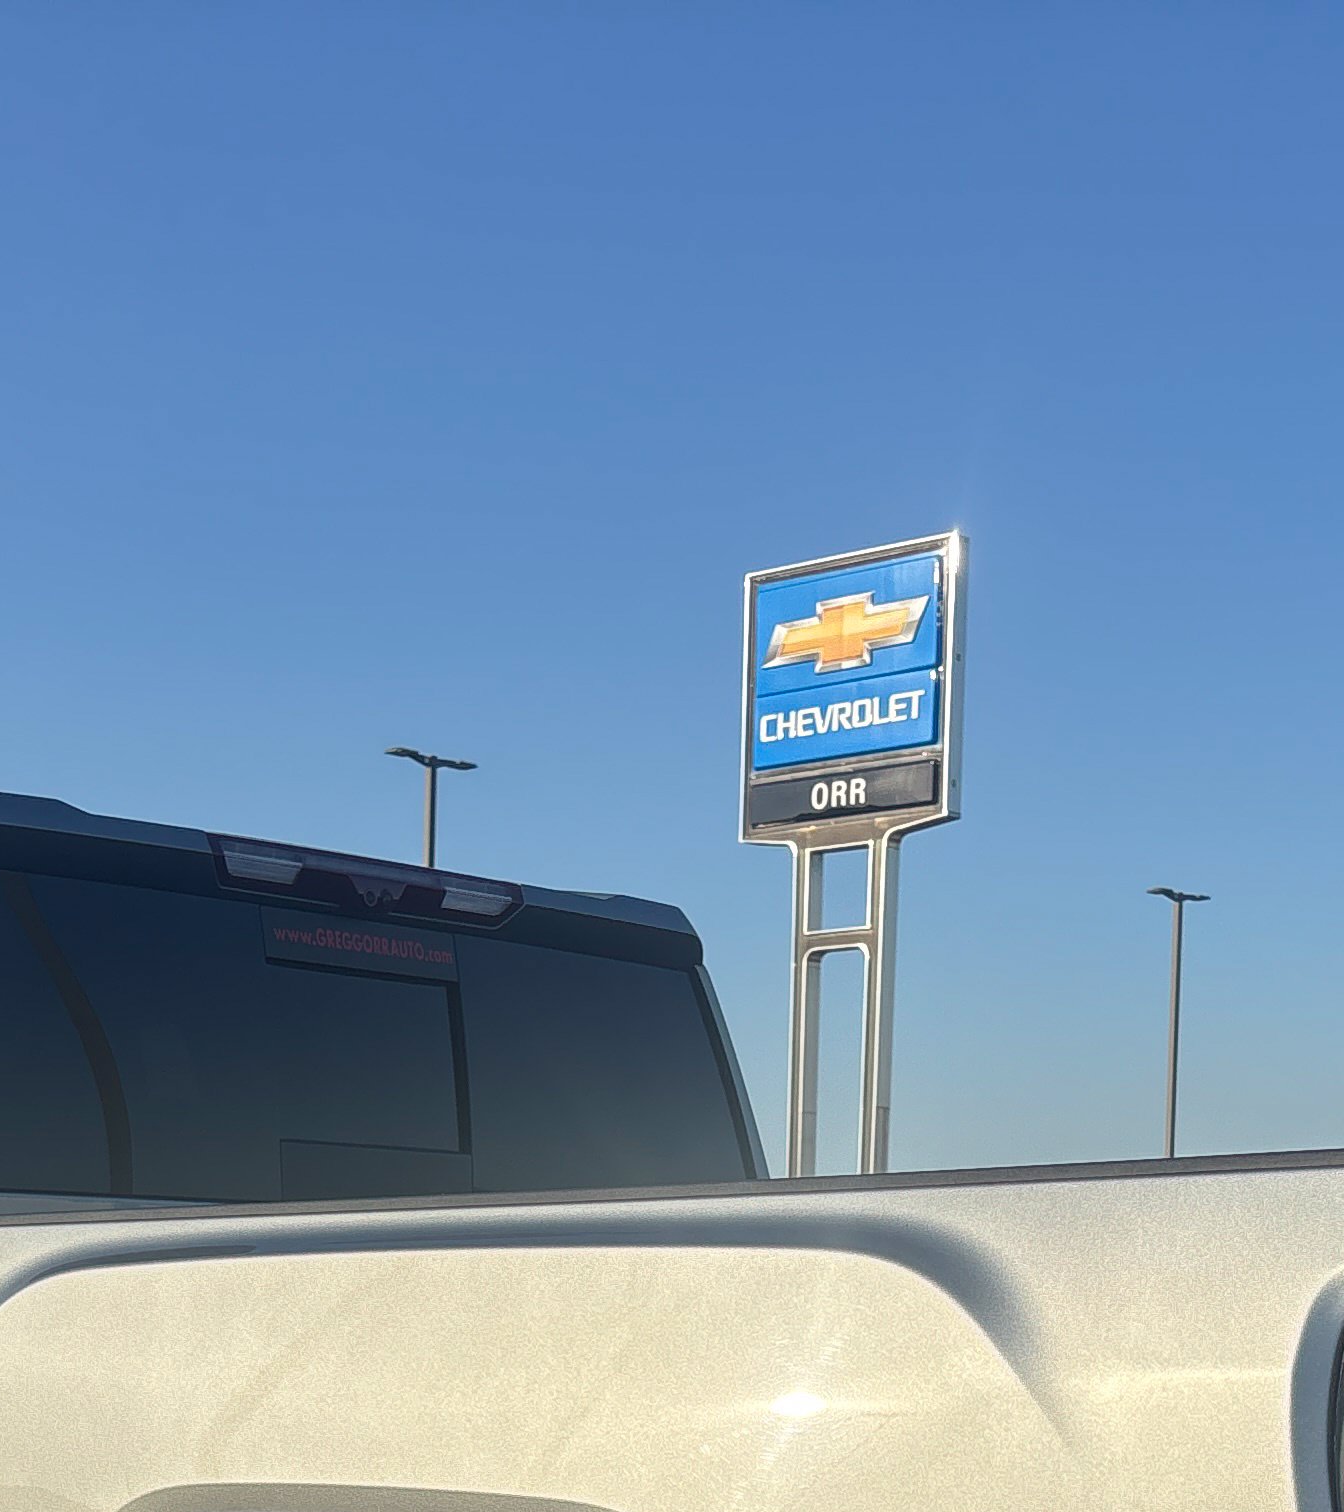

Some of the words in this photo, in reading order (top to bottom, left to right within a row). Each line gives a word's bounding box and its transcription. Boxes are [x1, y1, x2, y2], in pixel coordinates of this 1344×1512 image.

[759, 689, 926, 743] CHEVROLET
[811, 777, 867, 810] ORR
[272, 927, 453, 964] www.GREGGORRAUTO.com
